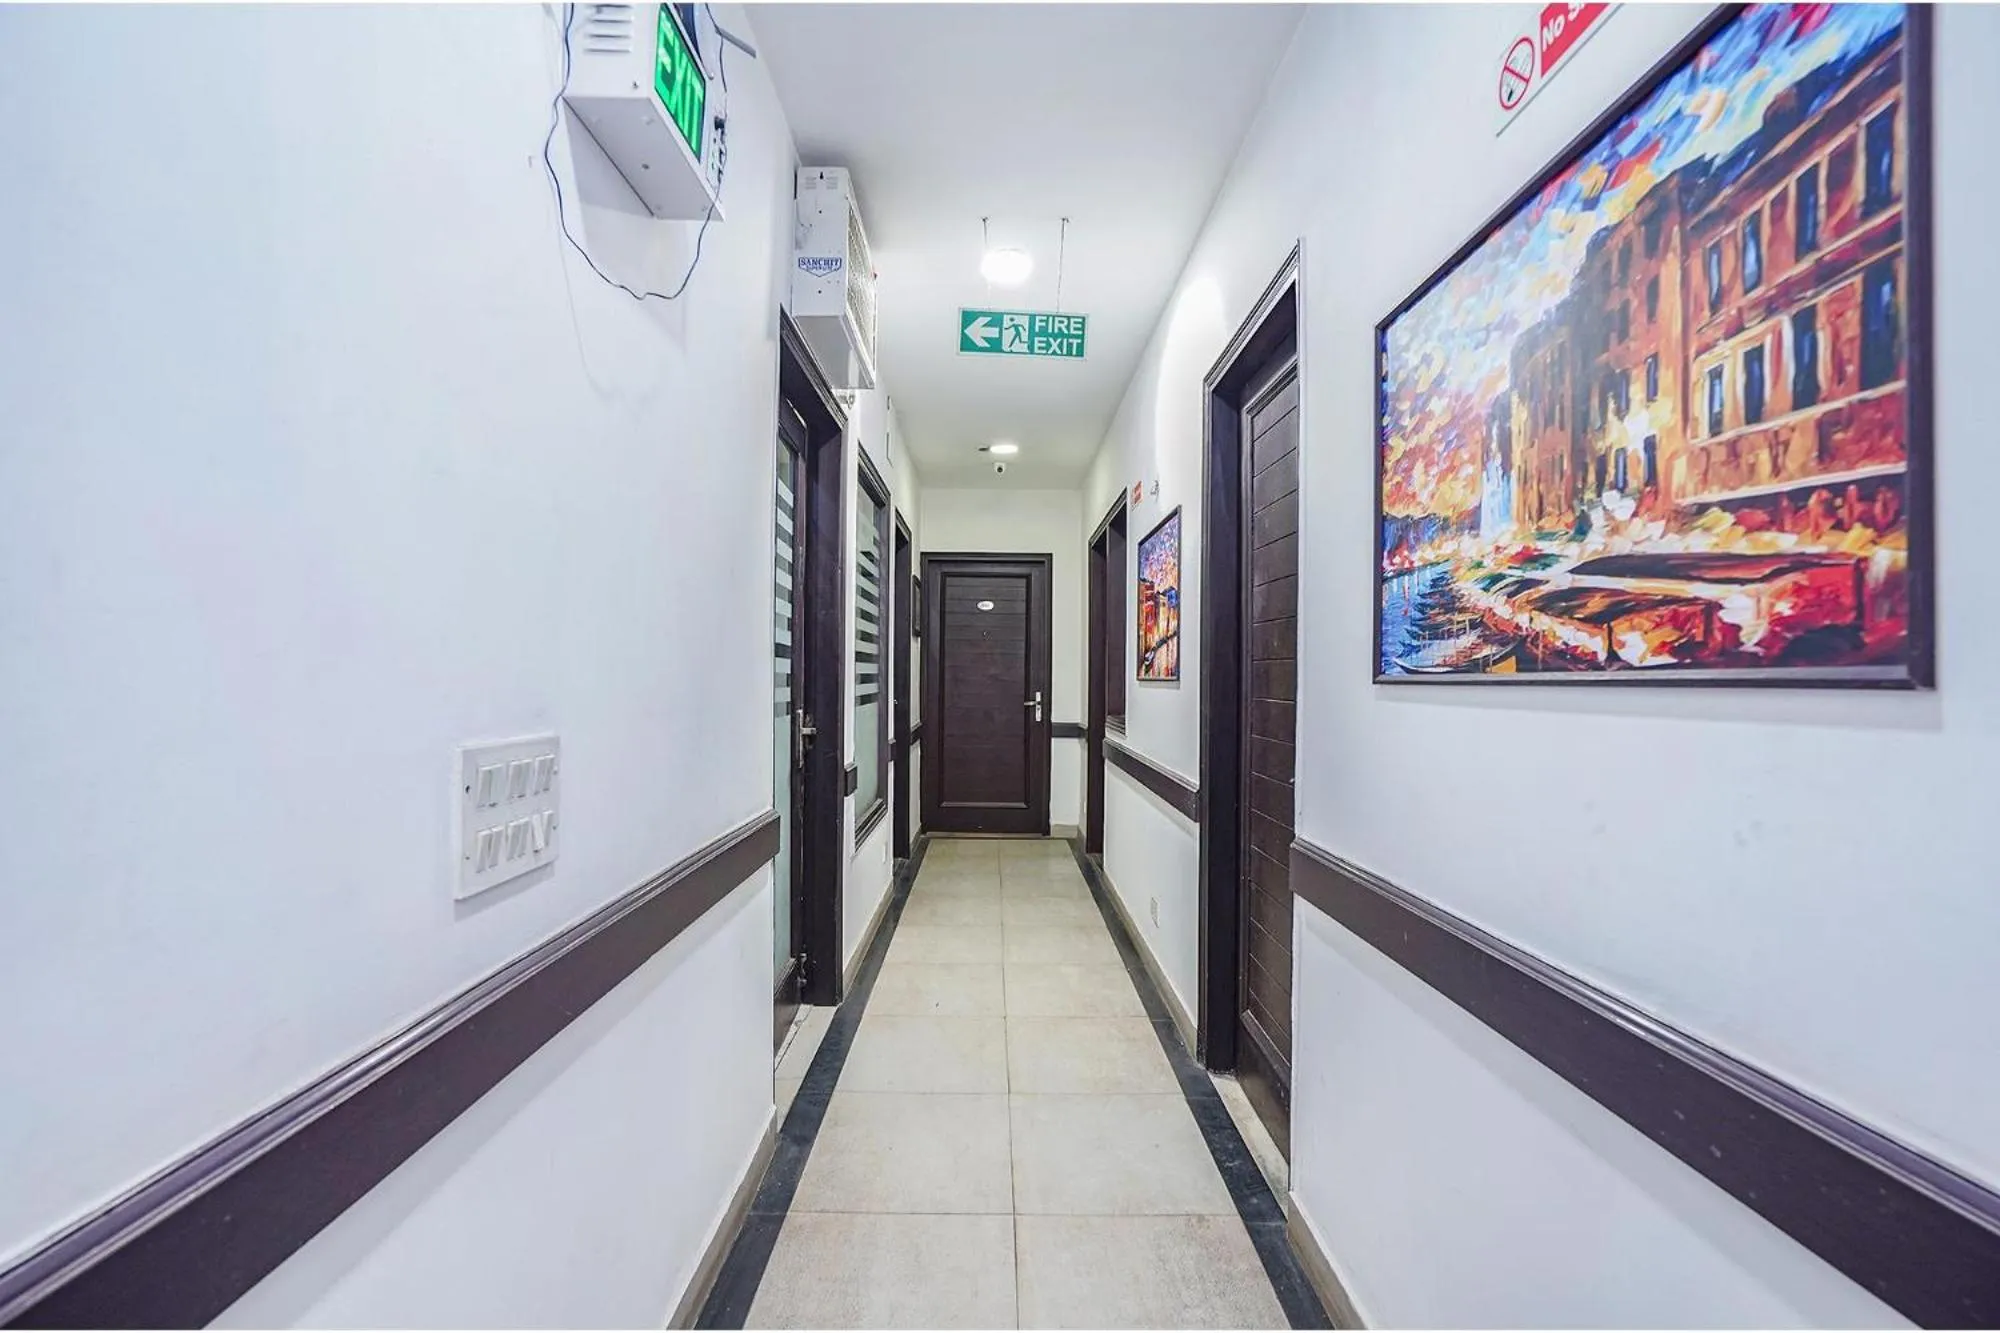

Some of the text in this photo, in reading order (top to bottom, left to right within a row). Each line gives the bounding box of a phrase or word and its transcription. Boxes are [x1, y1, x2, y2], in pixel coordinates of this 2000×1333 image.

[1542, 15, 1566, 52] No
[655, 10, 704, 152] EXIT
[800, 258, 839, 266] SANCHIT
[1035, 315, 1083, 335] FIRE
[1034, 337, 1081, 356] EXIT
